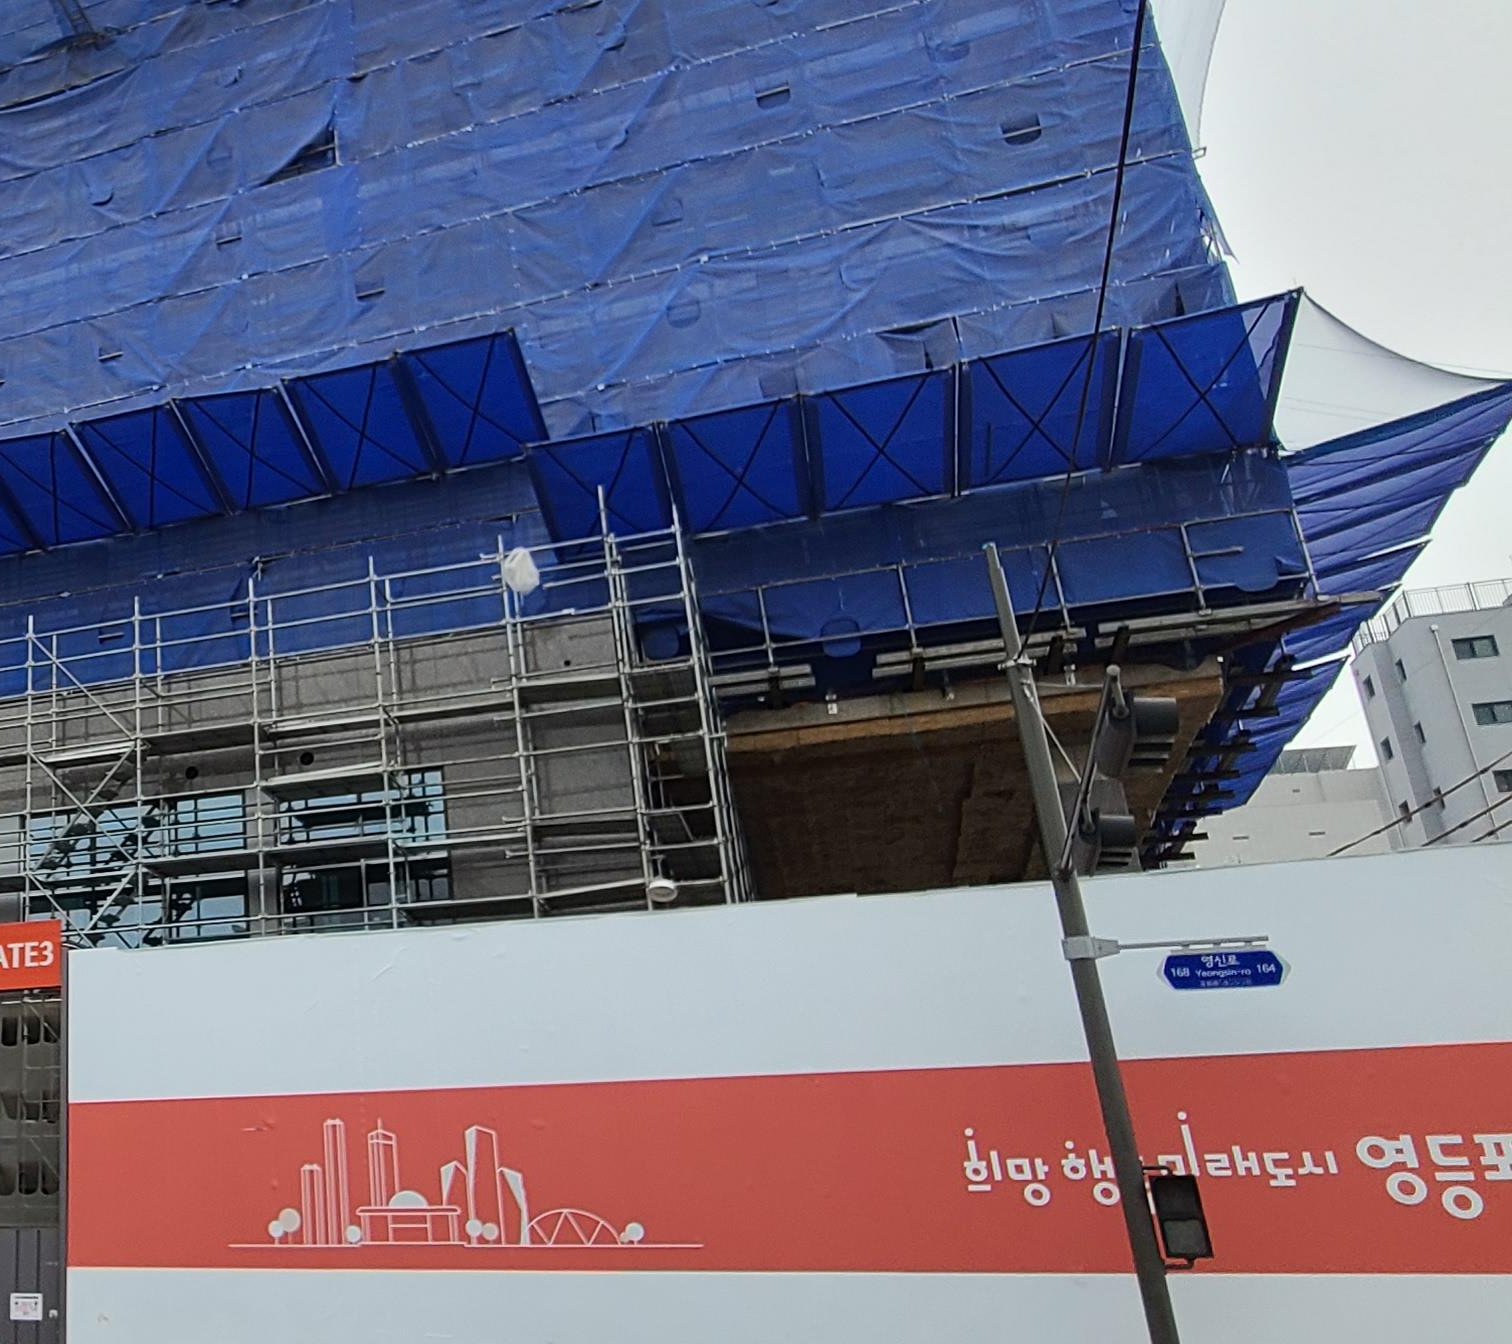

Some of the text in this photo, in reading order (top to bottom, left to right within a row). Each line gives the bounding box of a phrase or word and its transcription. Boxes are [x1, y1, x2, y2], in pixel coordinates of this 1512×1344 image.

[1200, 954, 1241, 969] 영신로
[1170, 963, 1276, 979] 168 Yeongsin-ro 164
[963, 1127, 1049, 1206] 희망
[1157, 1111, 1339, 1188] 미래도시
